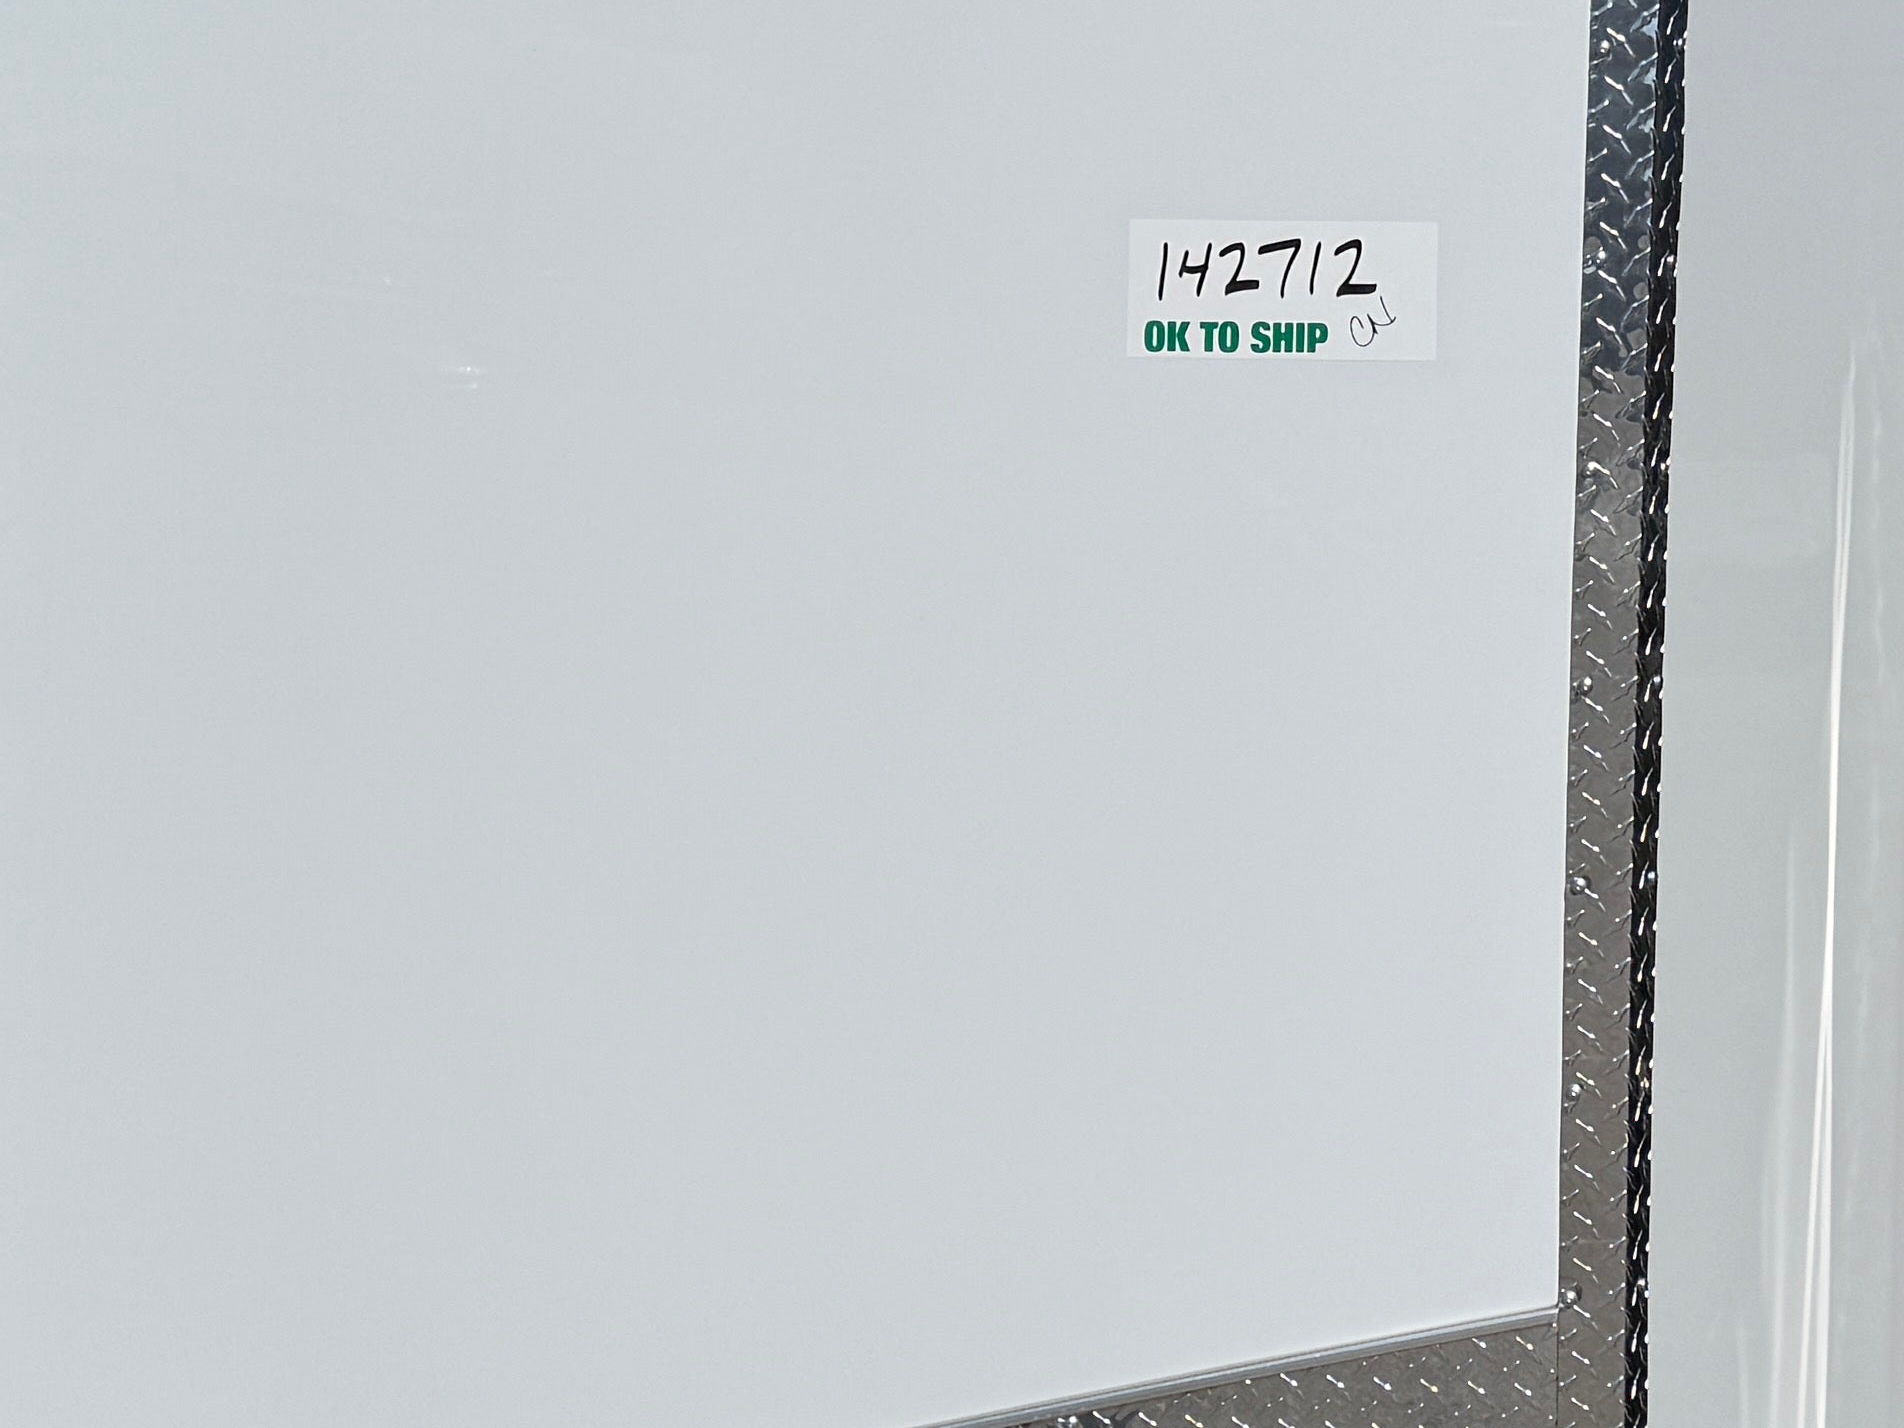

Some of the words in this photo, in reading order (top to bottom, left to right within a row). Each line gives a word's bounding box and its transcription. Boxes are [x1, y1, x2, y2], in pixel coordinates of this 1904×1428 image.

[1158, 238, 1377, 301] 142712
[1144, 320, 1191, 352] OK
[1200, 320, 1240, 353] TO
[1250, 321, 1329, 353] SHIP
